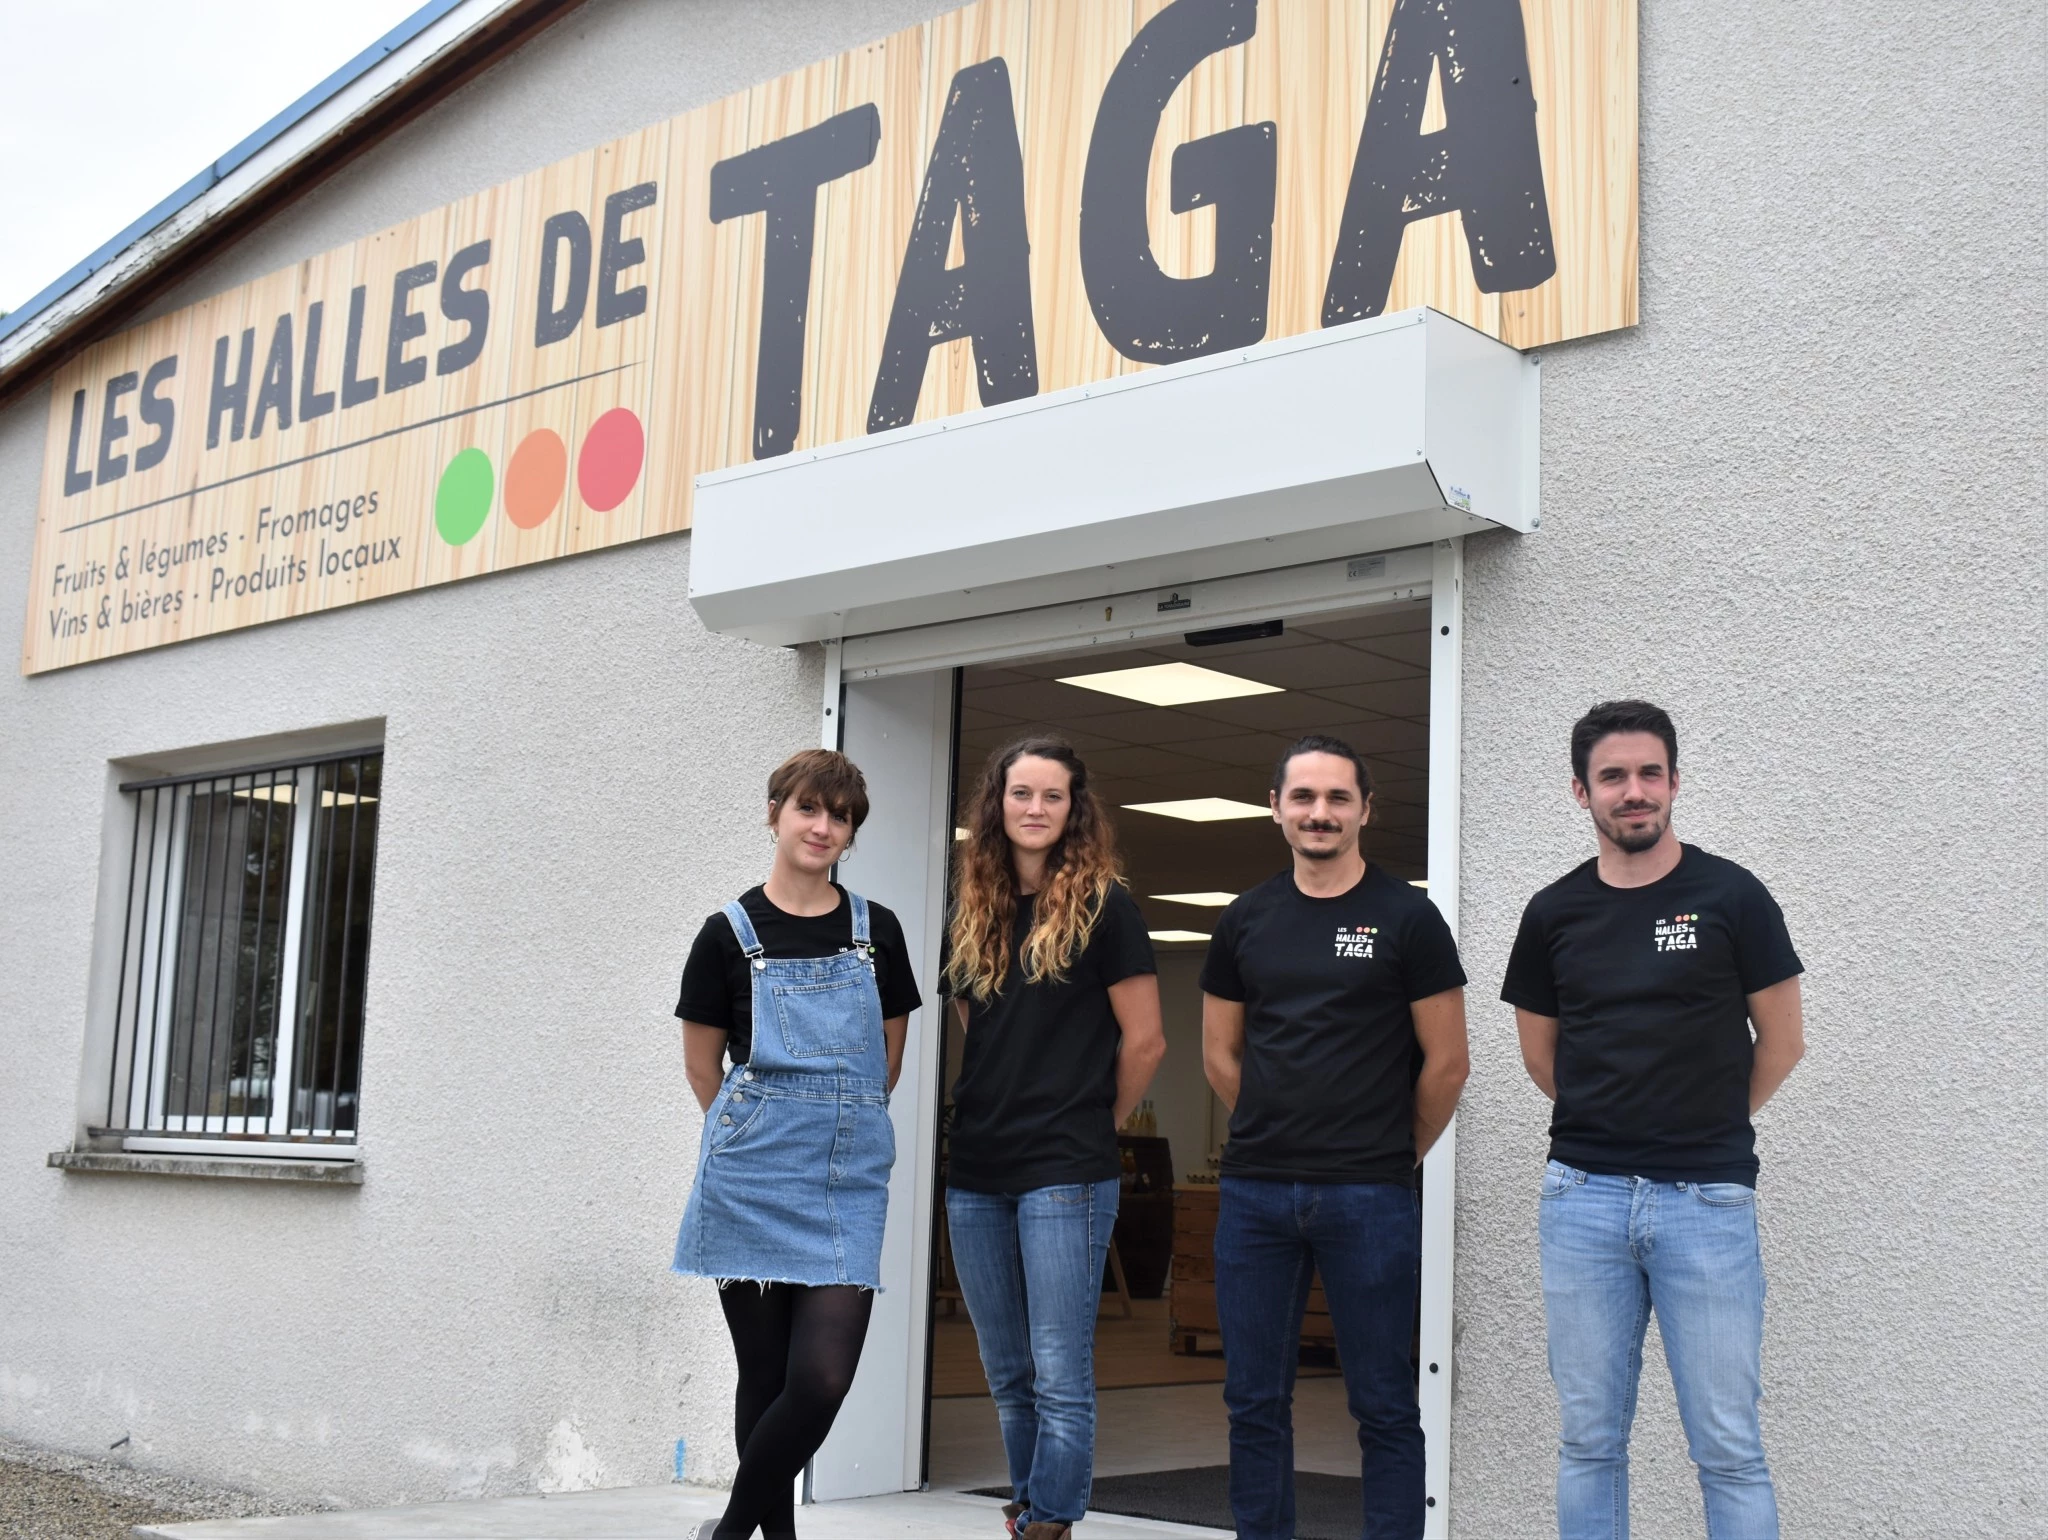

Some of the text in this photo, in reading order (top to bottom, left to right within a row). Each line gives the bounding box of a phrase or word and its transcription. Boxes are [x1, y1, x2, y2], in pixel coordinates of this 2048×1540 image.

[63, 0, 1557, 497] LES HALLES DE TAGA
[52, 490, 379, 597] Fruits & légumes Fromages
[49, 536, 401, 641] Vins & bières Produits locaux
[1655, 923, 1688, 935] HALLES
[1335, 934, 1368, 943] HALLES
[1654, 933, 1697, 951] TAGA
[1334, 943, 1373, 958] TAGA
